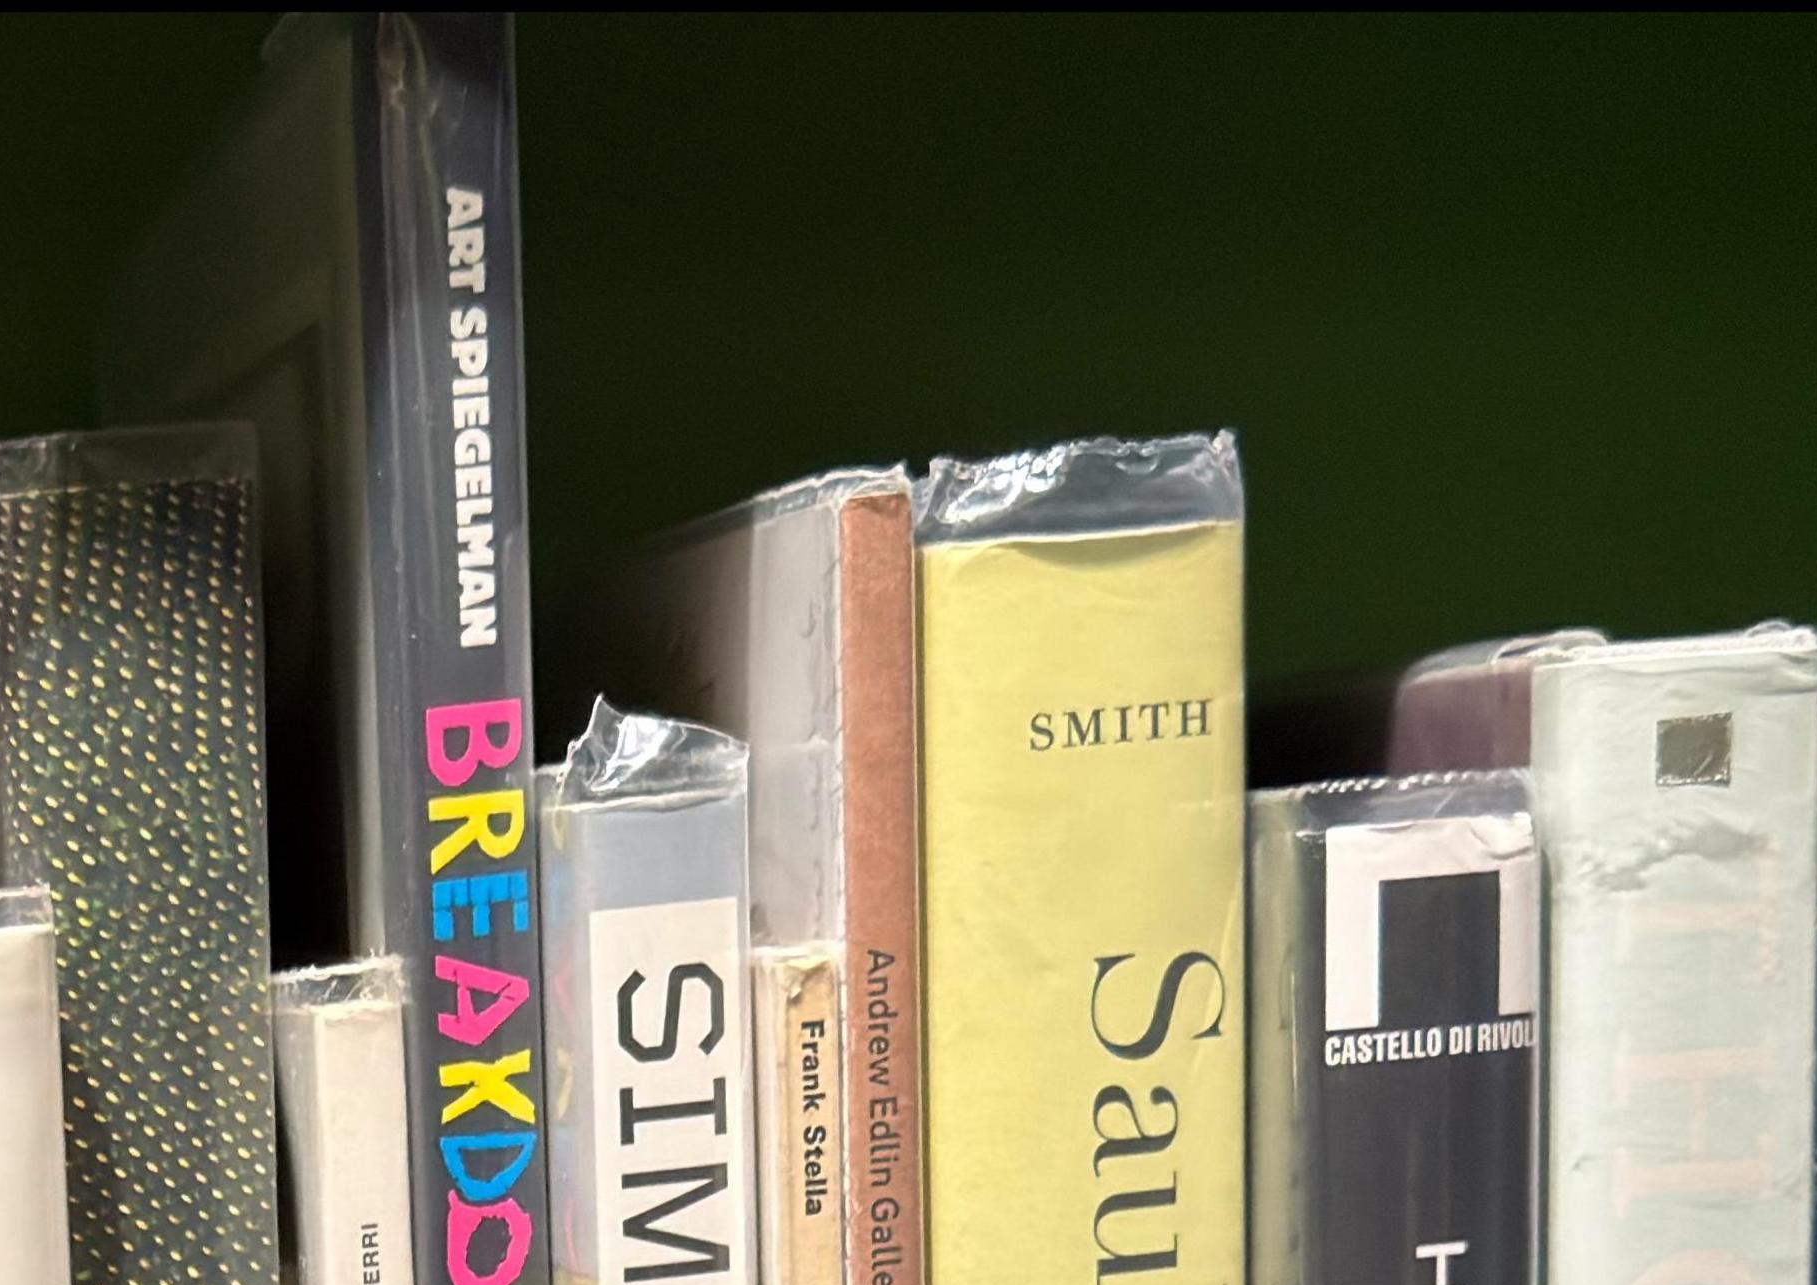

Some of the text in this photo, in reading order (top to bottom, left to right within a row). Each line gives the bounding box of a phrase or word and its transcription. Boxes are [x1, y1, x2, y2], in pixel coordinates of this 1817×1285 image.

[447, 188, 497, 646] ART SPIEGELMAN
[1030, 698, 1213, 751] SMITH
[867, 950, 897, 1085] Andrew
[1324, 1026, 1443, 1067] CASTELLO
[802, 1020, 827, 1217] Frank Stella
[870, 1095, 900, 1187] Edlin
